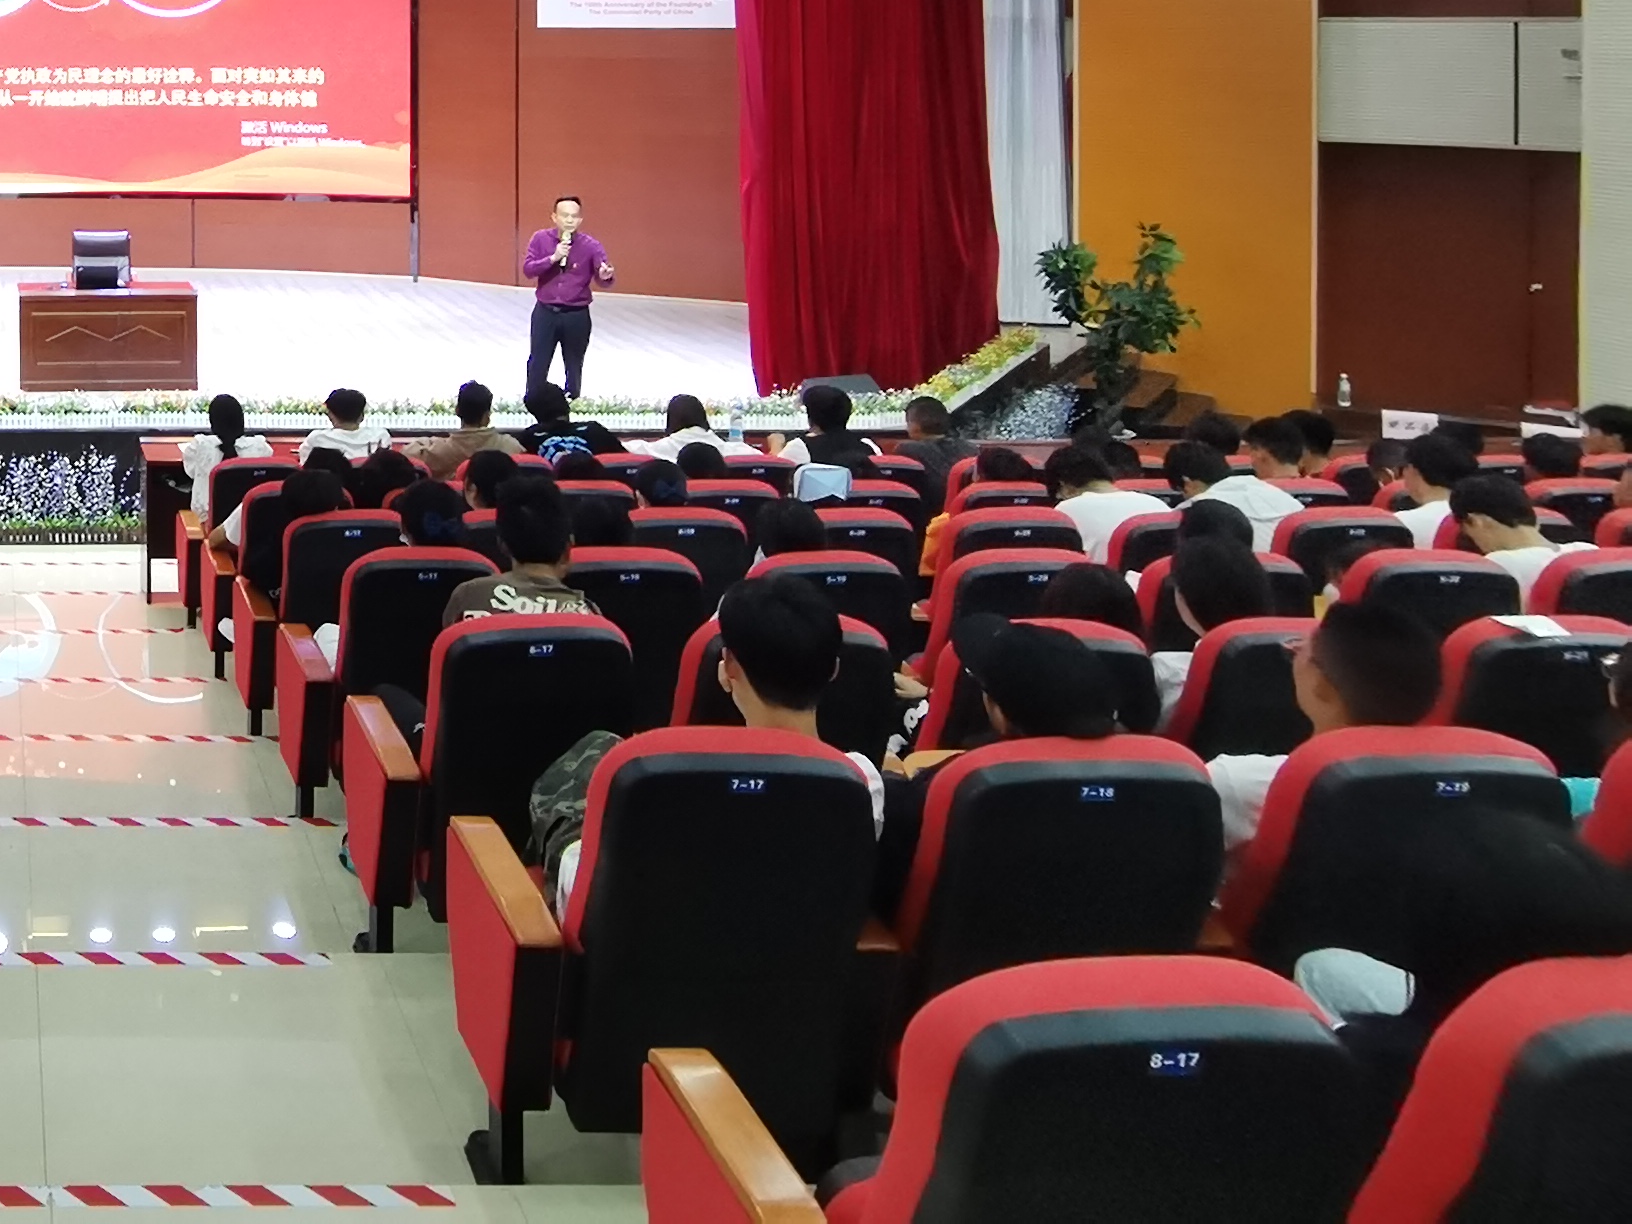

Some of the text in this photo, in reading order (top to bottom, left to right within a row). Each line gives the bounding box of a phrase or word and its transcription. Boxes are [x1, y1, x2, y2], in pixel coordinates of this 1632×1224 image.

[269, 120, 329, 134] Windows
[529, 644, 554, 654] 6-17
[731, 779, 764, 790] 7-17
[1081, 787, 1114, 798] 7-18
[1149, 1052, 1200, 1068] 8-17
